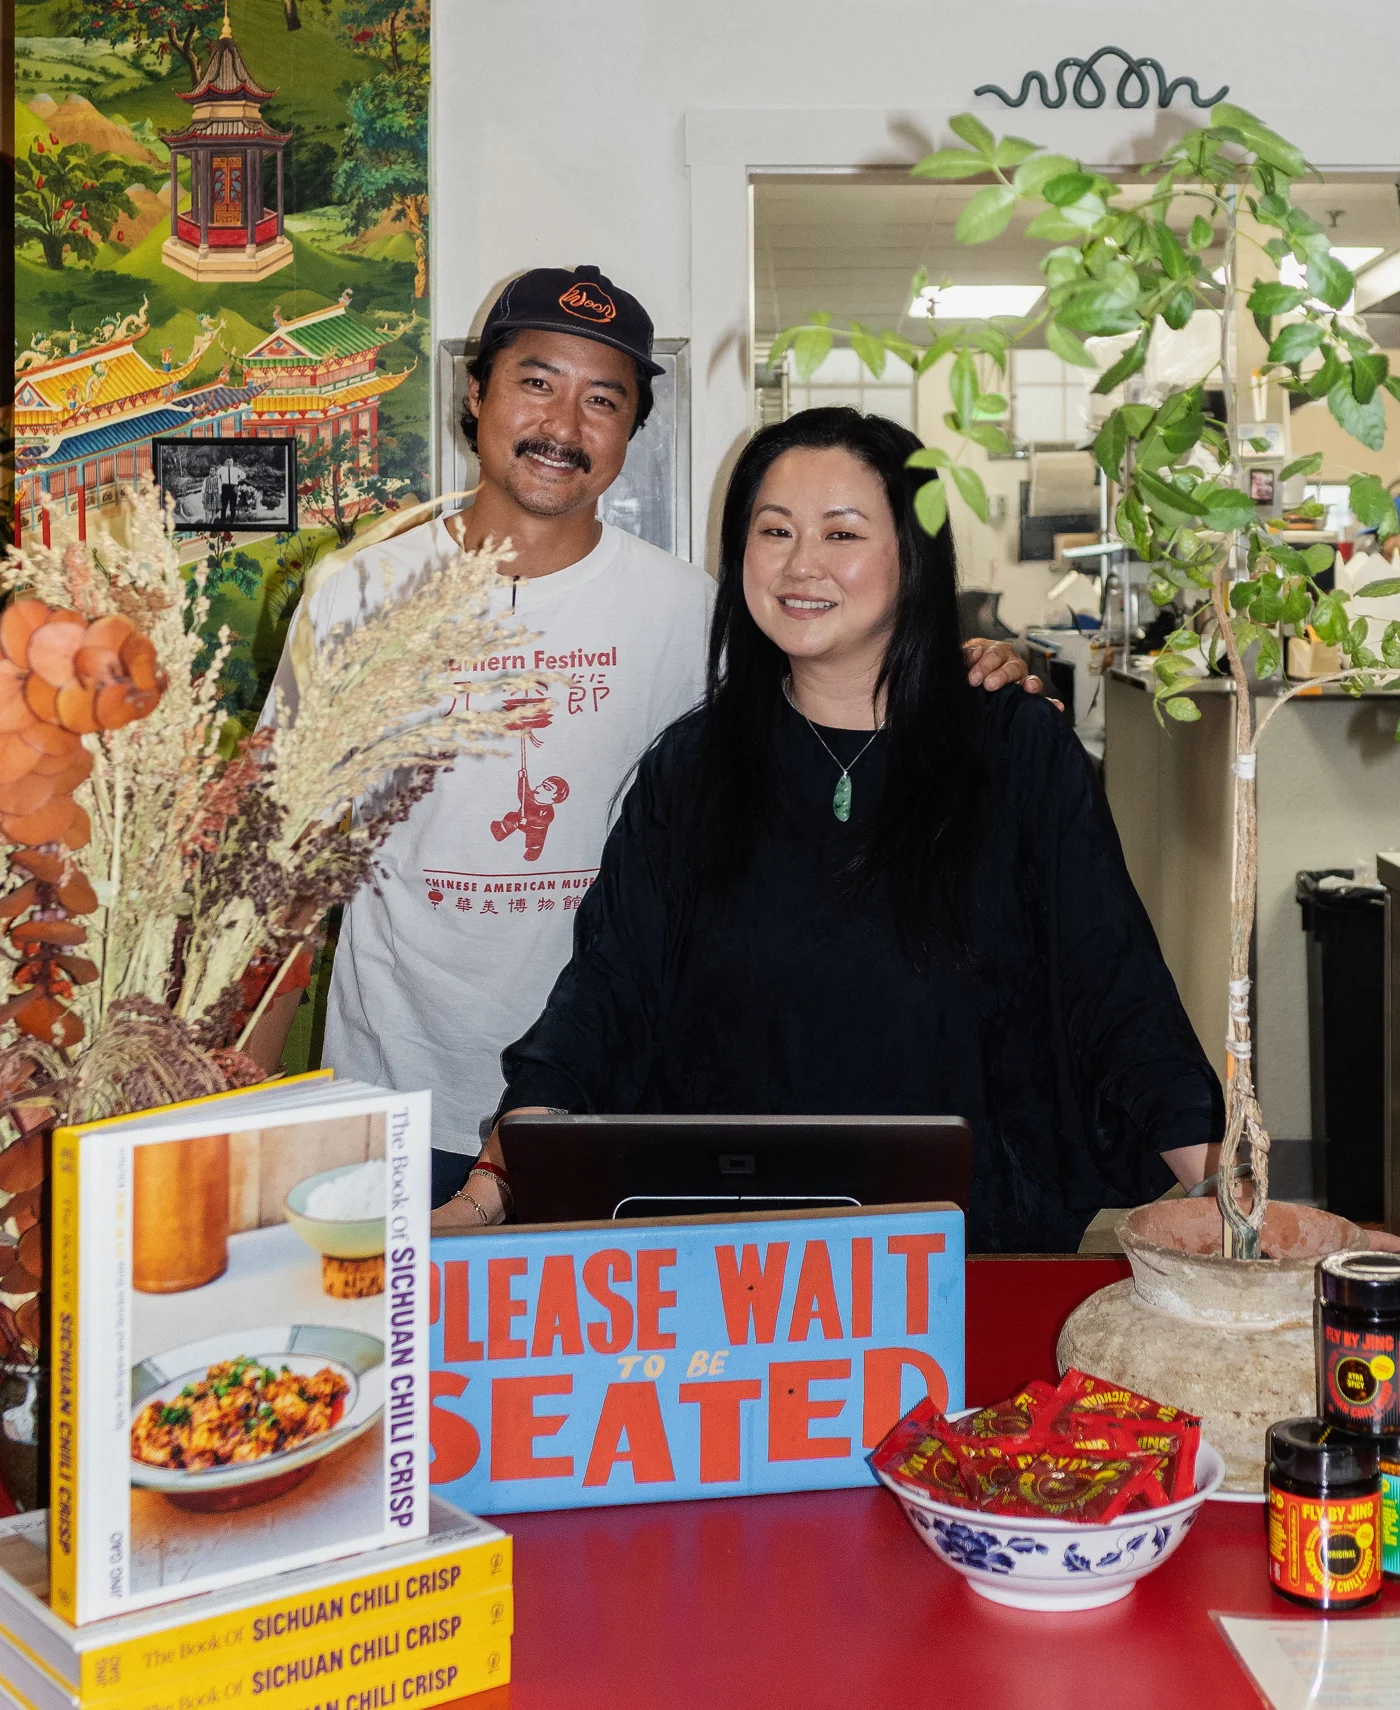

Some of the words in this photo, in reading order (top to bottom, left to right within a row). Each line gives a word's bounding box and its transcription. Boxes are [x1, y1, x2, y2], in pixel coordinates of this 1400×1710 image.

[447, 654, 526, 672] aern
[534, 646, 618, 669] Festival
[425, 878, 477, 892] CHINESE
[484, 880, 556, 893] AMERICAN
[562, 877, 595, 889] MUSE
[392, 1106, 410, 1149] The
[392, 1155, 410, 1211] Book
[391, 1215, 410, 1241] Of
[391, 1247, 416, 1368] SICHUAN
[430, 1247, 677, 1363] LEASE
[714, 1233, 946, 1346] WAIT
[1342, 1330, 1360, 1349] BY
[1362, 1333, 1395, 1352] JING
[58, 1312, 73, 1417] SICHUAN
[617, 1354, 665, 1379] TO
[686, 1350, 731, 1377] BE
[390, 1373, 415, 1444] CHILI
[429, 1346, 949, 1487] SEATED
[1079, 1390, 1132, 1409] SICHUAN
[58, 1420, 73, 1483] CHILI
[389, 1450, 415, 1528] CRISP
[1302, 1503, 1325, 1521] FLY
[1327, 1506, 1347, 1522] BY
[1347, 1501, 1374, 1520] JING
[57, 1486, 72, 1556] CRISP
[109, 1530, 124, 1564] GAO
[1327, 1549, 1356, 1559] ORIGINAL
[109, 1566, 124, 1600] JING
[143, 1649, 175, 1669] The
[179, 1633, 221, 1660] Book
[224, 1625, 245, 1646] Of
[253, 1597, 344, 1642] SICHUAN
[350, 1579, 400, 1615] CHILI
[405, 1565, 462, 1599] CRISP
[179, 1686, 221, 1710] Book
[224, 1678, 244, 1699] Of
[252, 1648, 344, 1695] SICHUAN
[349, 1630, 400, 1666] CHILI
[405, 1615, 462, 1650] CRISP
[346, 1680, 396, 1710] CHILI
[402, 1665, 458, 1700] CRISP
